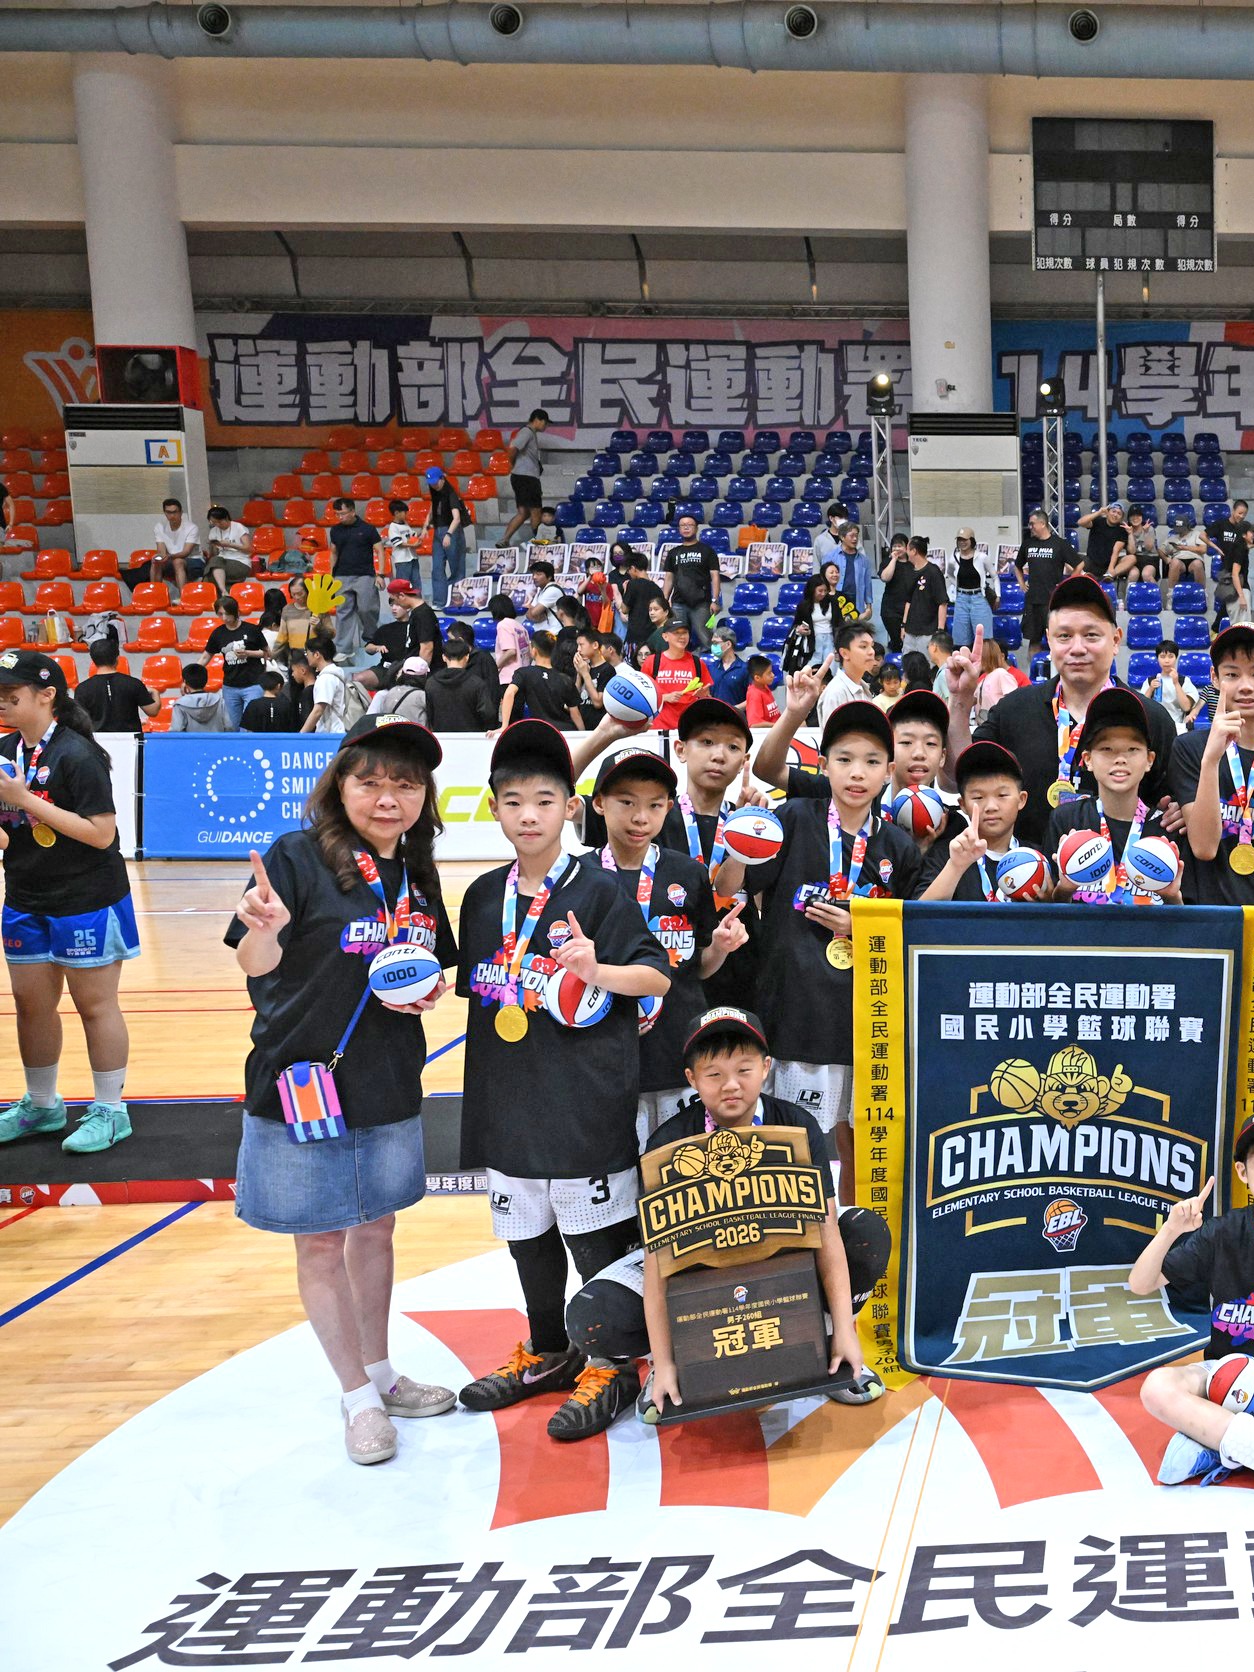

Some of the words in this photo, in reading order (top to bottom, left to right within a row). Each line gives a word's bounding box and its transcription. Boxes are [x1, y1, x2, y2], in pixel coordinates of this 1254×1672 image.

[1049, 213, 1073, 226] 得分
[1113, 214, 1137, 228] 局數
[1176, 215, 1200, 228] 得分
[1036, 257, 1073, 270] 犯規次數
[1085, 257, 1165, 271] 球員犯規次數
[1177, 258, 1214, 272] 犯規次數
[157, 445, 171, 460] A
[657, 670, 671, 678] WU
[674, 670, 693, 678] HUA
[610, 680, 634, 701] 1000
[197, 831, 273, 844] GUIDANCE
[1078, 842, 1104, 866] conti
[1090, 858, 1112, 879] 1000
[1134, 854, 1167, 876] conti
[73, 928, 96, 948] 25
[376, 947, 416, 964] conti
[382, 966, 418, 985] 1000
[968, 981, 1177, 1010] 運動部全民運動署
[939, 1014, 1204, 1043] 國民小學籃球聯賽
[798, 1089, 822, 1102] LP
[941, 1124, 1196, 1194] CHAMPIONS
[493, 1191, 509, 1206] LP
[589, 1173, 611, 1205] 3
[649, 1173, 816, 1232] CHAMPIONS
[932, 1189, 1001, 1219] ELEMENTARY
[1004, 1187, 1046, 1201] SCHOOL
[1048, 1186, 1116, 1200] BASKETBALL
[1118, 1191, 1159, 1209] LEAGUE
[649, 1227, 693, 1251] ELEMENTARY
[695, 1220, 722, 1233] SCHOOL
[723, 1212, 768, 1226] BASKETBALL
[769, 1211, 797, 1220] LEAGUE
[1050, 1209, 1083, 1233] EBL
[714, 1222, 761, 1250] 2026
[939, 1264, 1198, 1367] 冠軍
[712, 1316, 784, 1360] 冠軍
